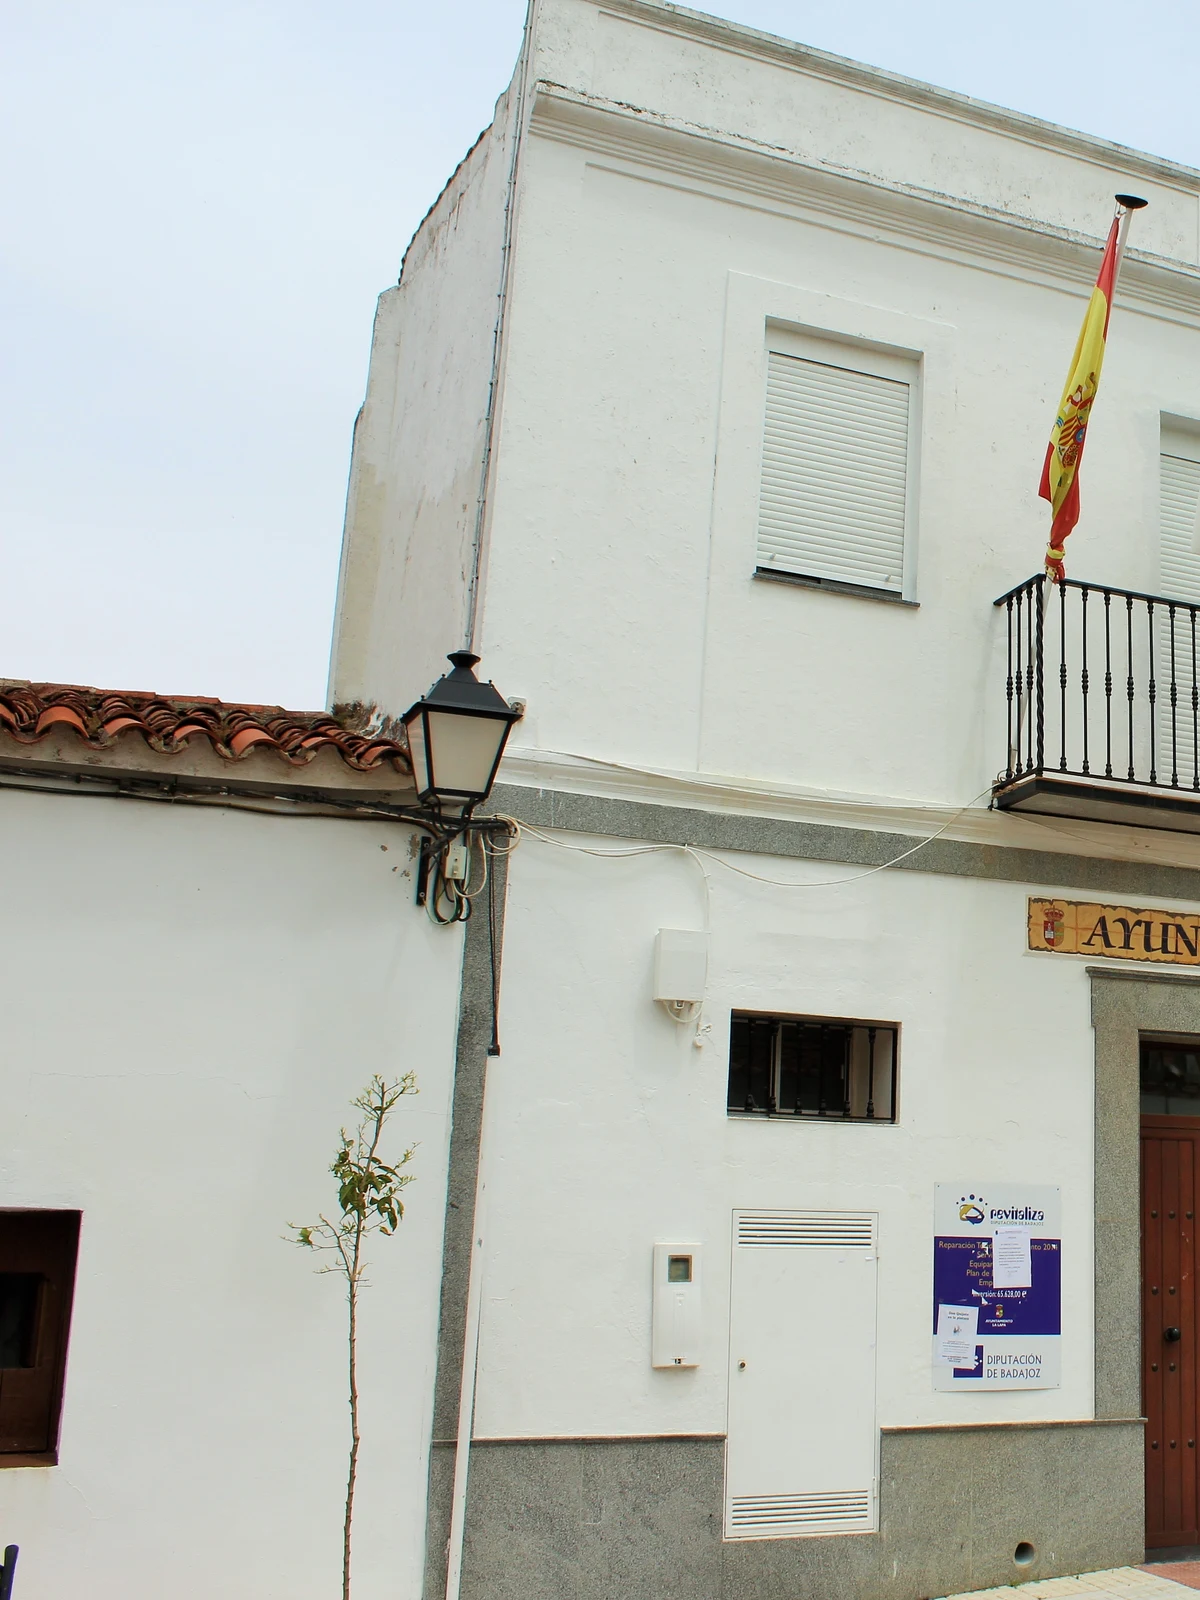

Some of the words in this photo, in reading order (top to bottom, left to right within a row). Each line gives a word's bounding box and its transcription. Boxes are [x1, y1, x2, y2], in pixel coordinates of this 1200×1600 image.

[990, 1206, 1044, 1221] revitaliza
[938, 1241, 976, 1250] Reparación
[987, 1353, 1042, 1364] DIPUTACIÓN
[987, 1369, 998, 1378] DE
[1000, 1368, 1040, 1379] BADAJOZ
